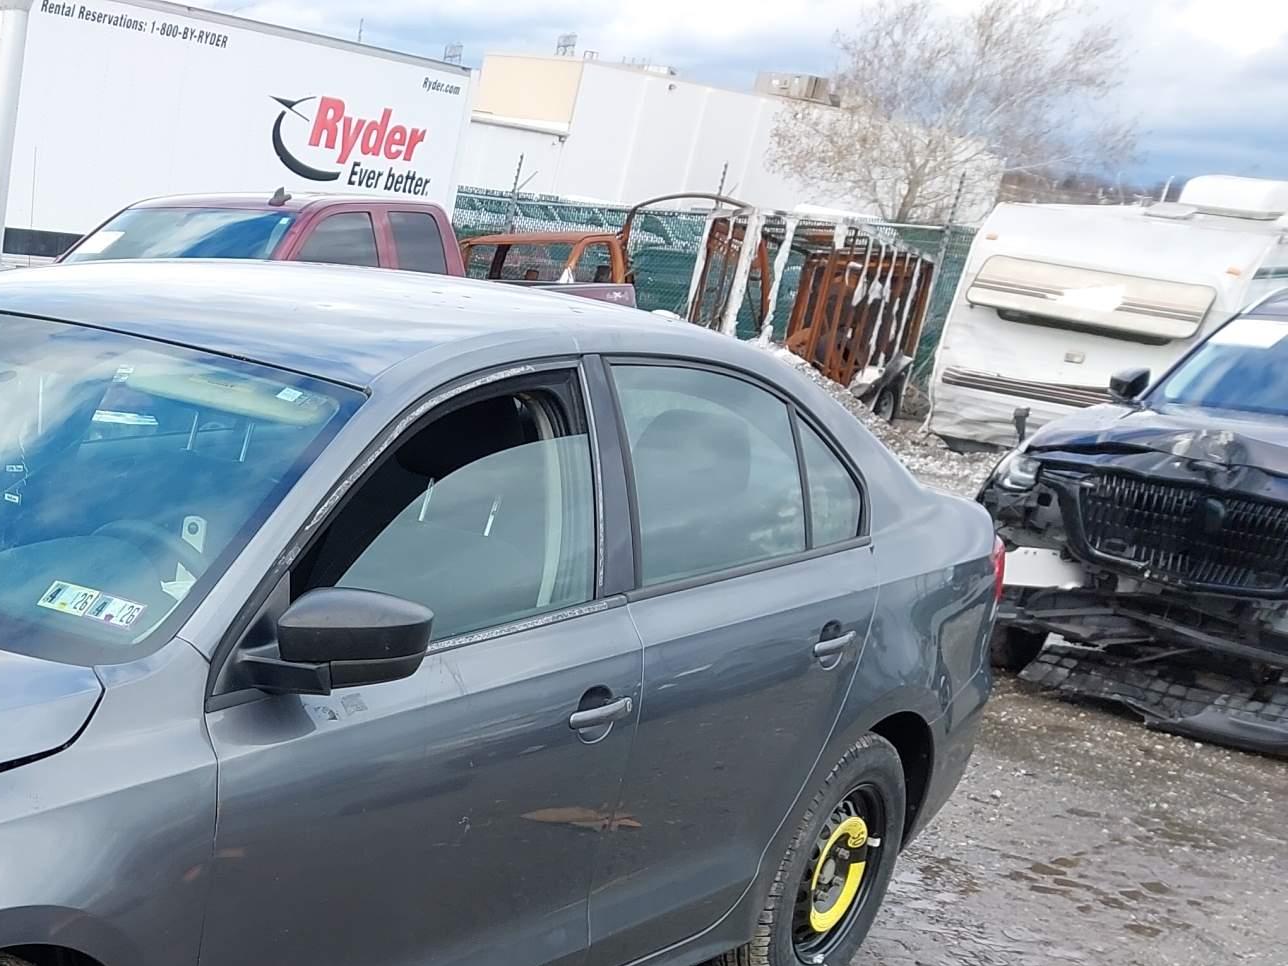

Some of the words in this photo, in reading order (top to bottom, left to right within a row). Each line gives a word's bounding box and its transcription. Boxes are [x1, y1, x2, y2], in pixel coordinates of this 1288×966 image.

[40, 0, 75, 18] Rental
[77, 5, 147, 33] Reservations:
[150, 20, 229, 48] 1-800-BY-RYDER
[422, 76, 461, 95] Ryder.com
[308, 95, 427, 165] Ryder
[347, 161, 384, 189] Ever
[383, 166, 431, 197] better.
[73, 592, 94, 611] 26
[93, 601, 108, 616] 4
[120, 605, 141, 624] 26
